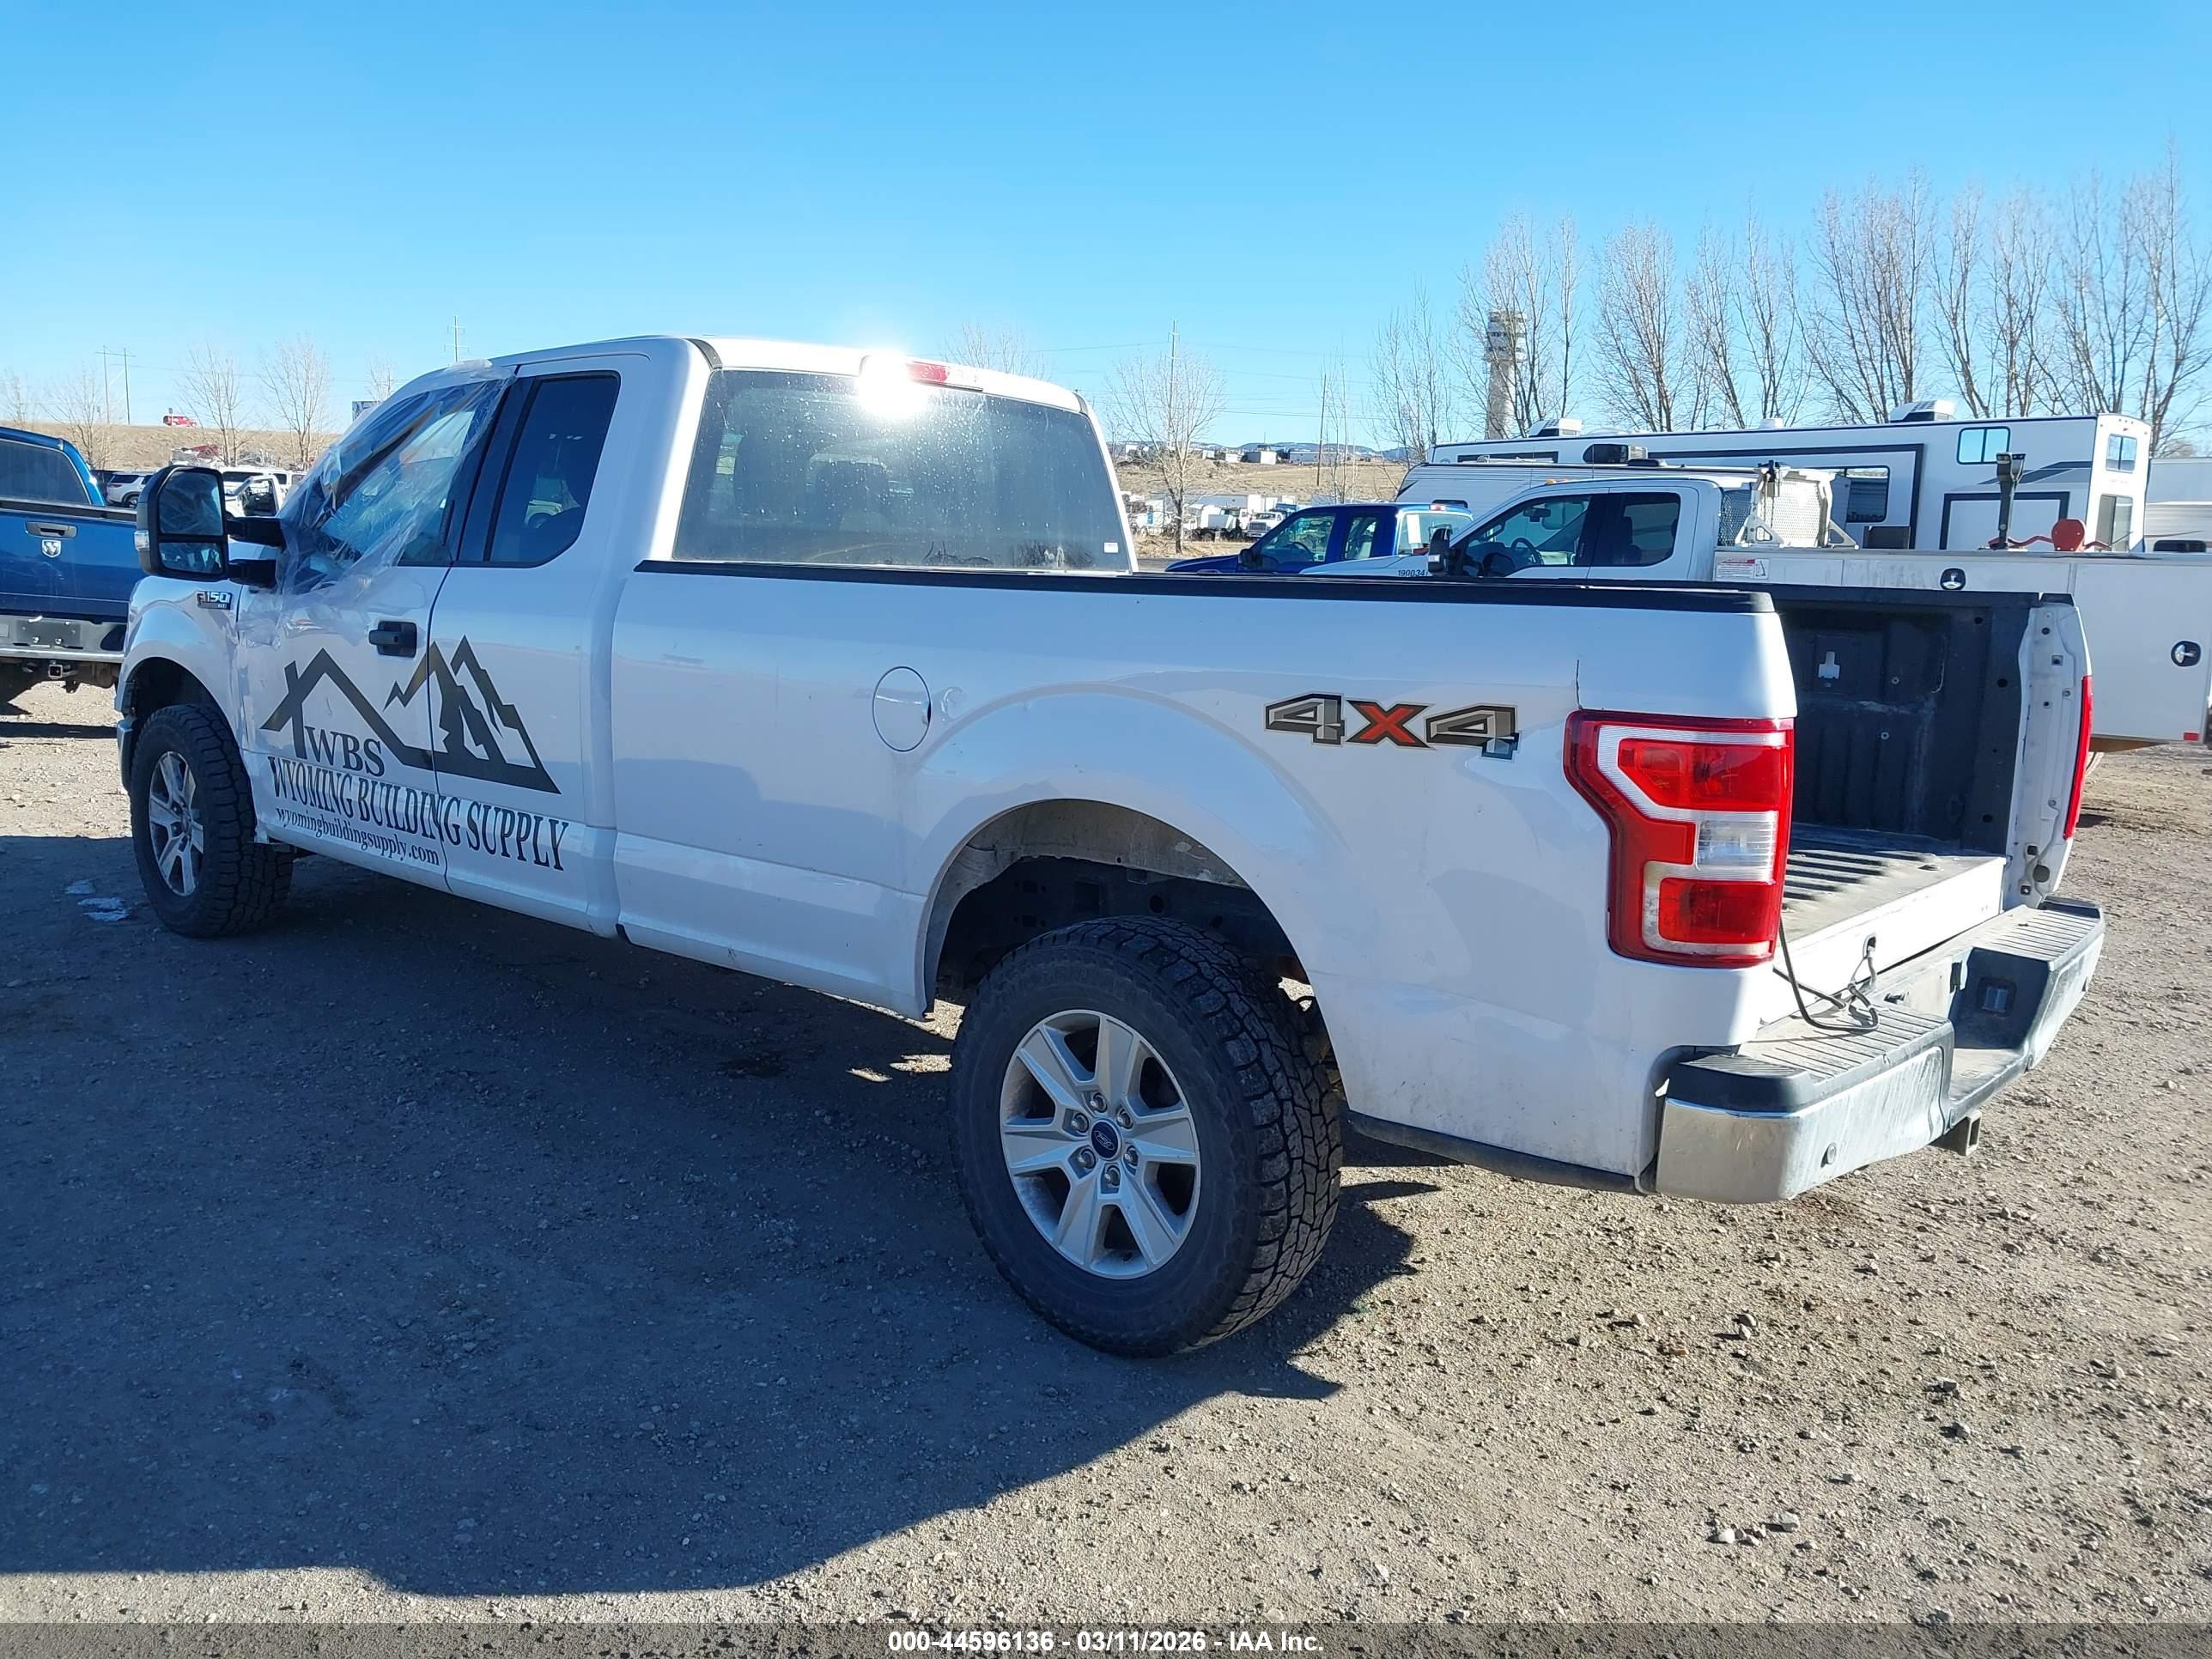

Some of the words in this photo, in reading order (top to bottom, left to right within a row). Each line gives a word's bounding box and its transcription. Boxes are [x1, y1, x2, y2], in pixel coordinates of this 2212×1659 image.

[304, 726, 385, 776] WBS
[268, 757, 353, 817] WYOMING
[358, 777, 461, 845] BUILDING
[466, 801, 569, 871] SUPPLY
[276, 808, 440, 866] wyomingbuildingsupply.com
